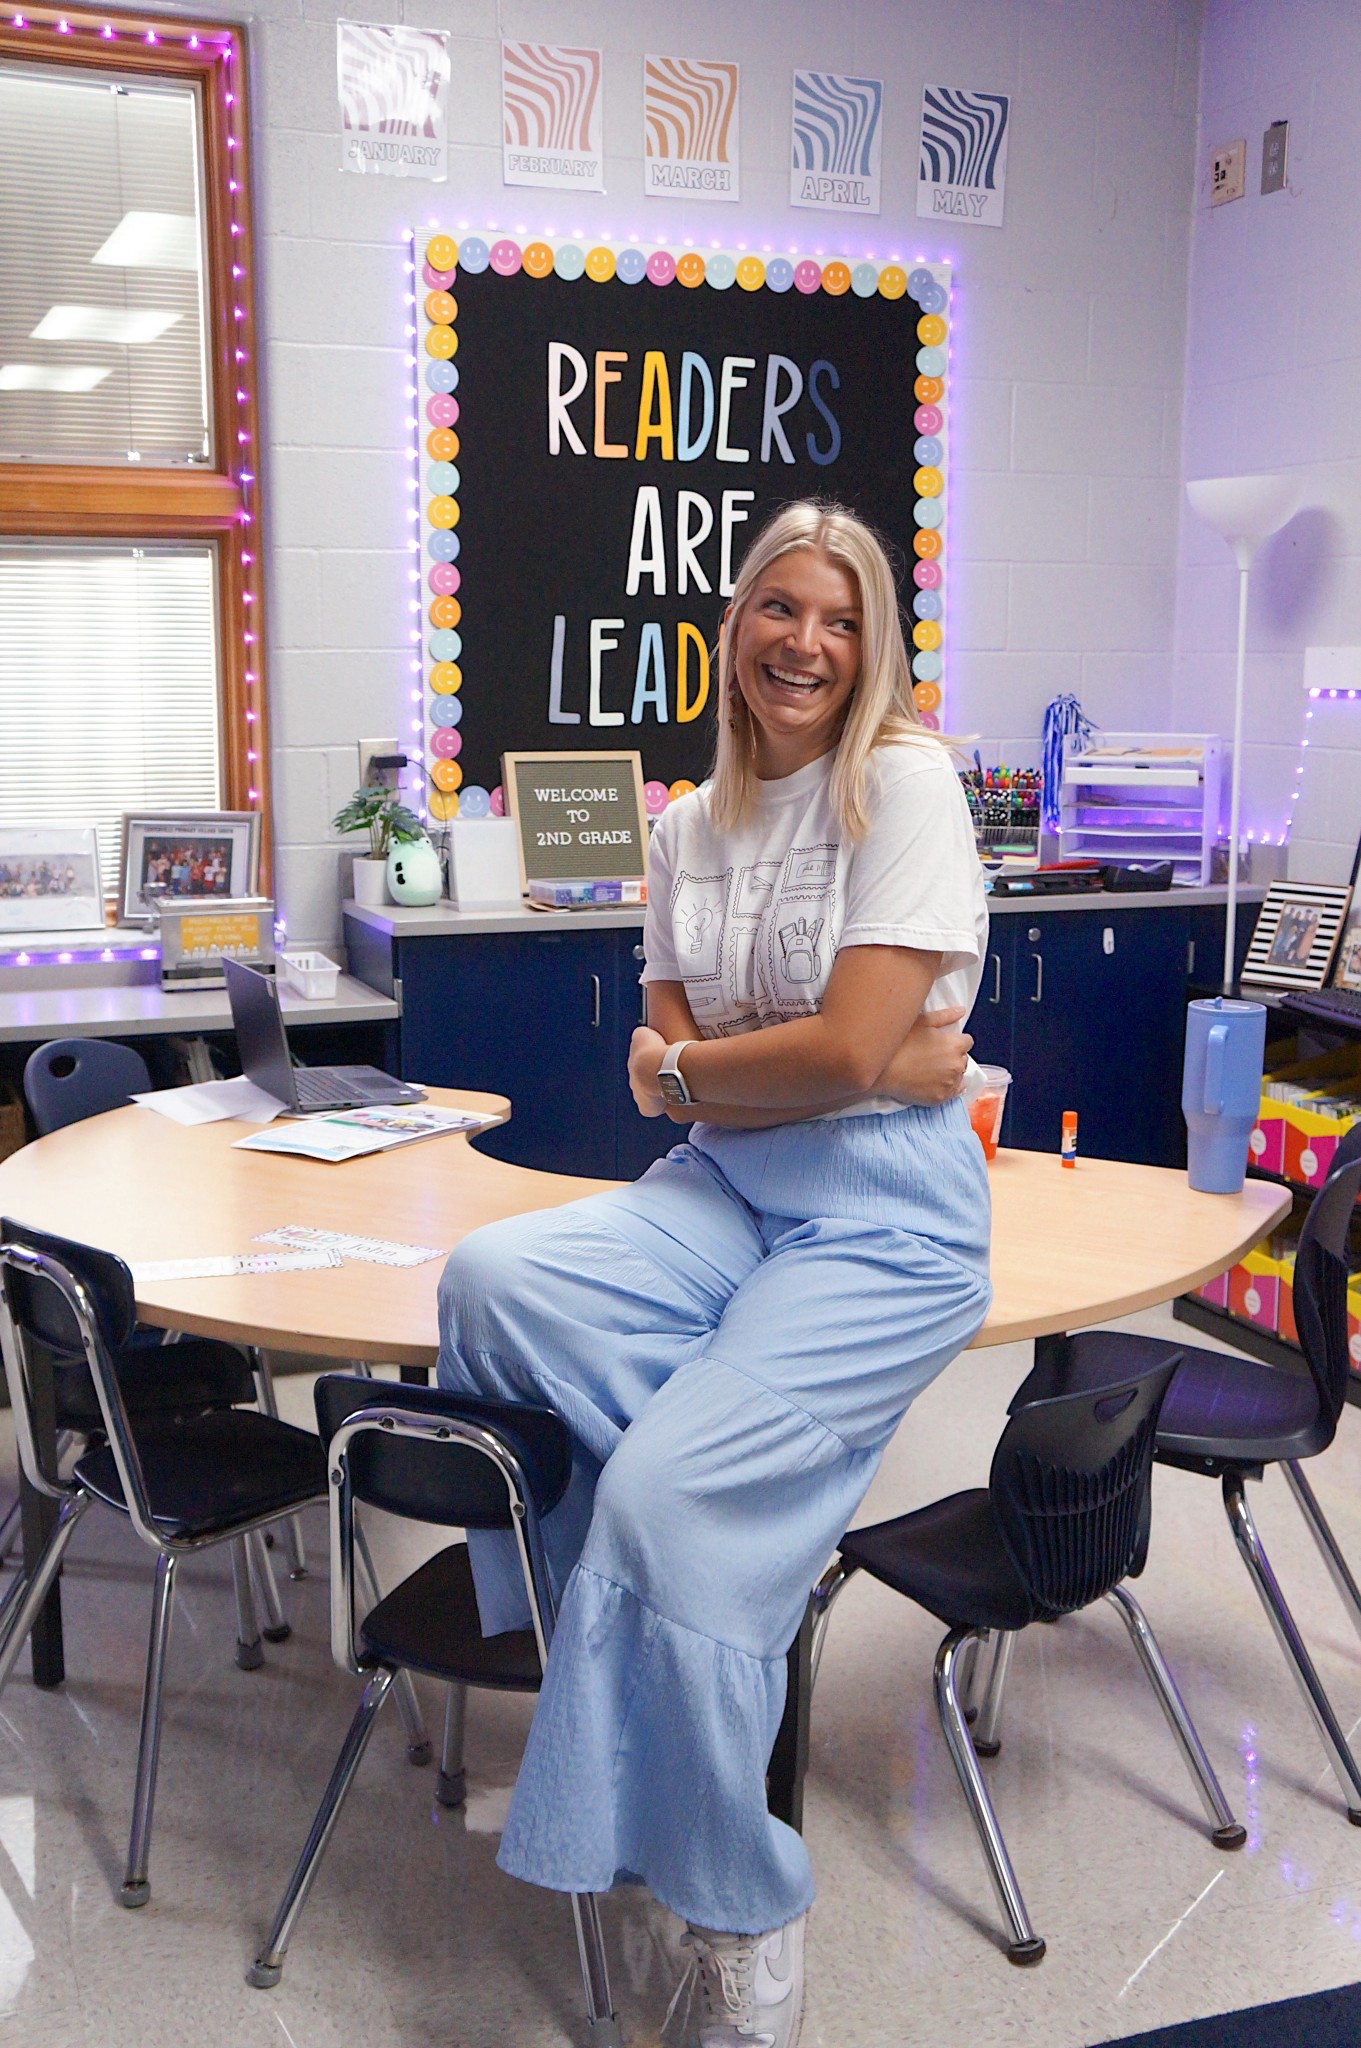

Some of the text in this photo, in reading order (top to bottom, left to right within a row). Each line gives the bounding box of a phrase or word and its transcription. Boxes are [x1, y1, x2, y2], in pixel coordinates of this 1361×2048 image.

[349, 139, 441, 166] JANUARY
[508, 154, 598, 177] FEBRUARY
[651, 164, 731, 191] MARCH
[800, 175, 870, 206] APRIL
[932, 188, 988, 218] MAY
[547, 341, 842, 466] READERS
[625, 485, 755, 598] ARE
[548, 614, 727, 728] LEAD
[534, 788, 618, 802] WELCOME
[566, 809, 590, 823] TO
[536, 830, 632, 846] 2ND GRADE
[343, 1243, 397, 1257] John
